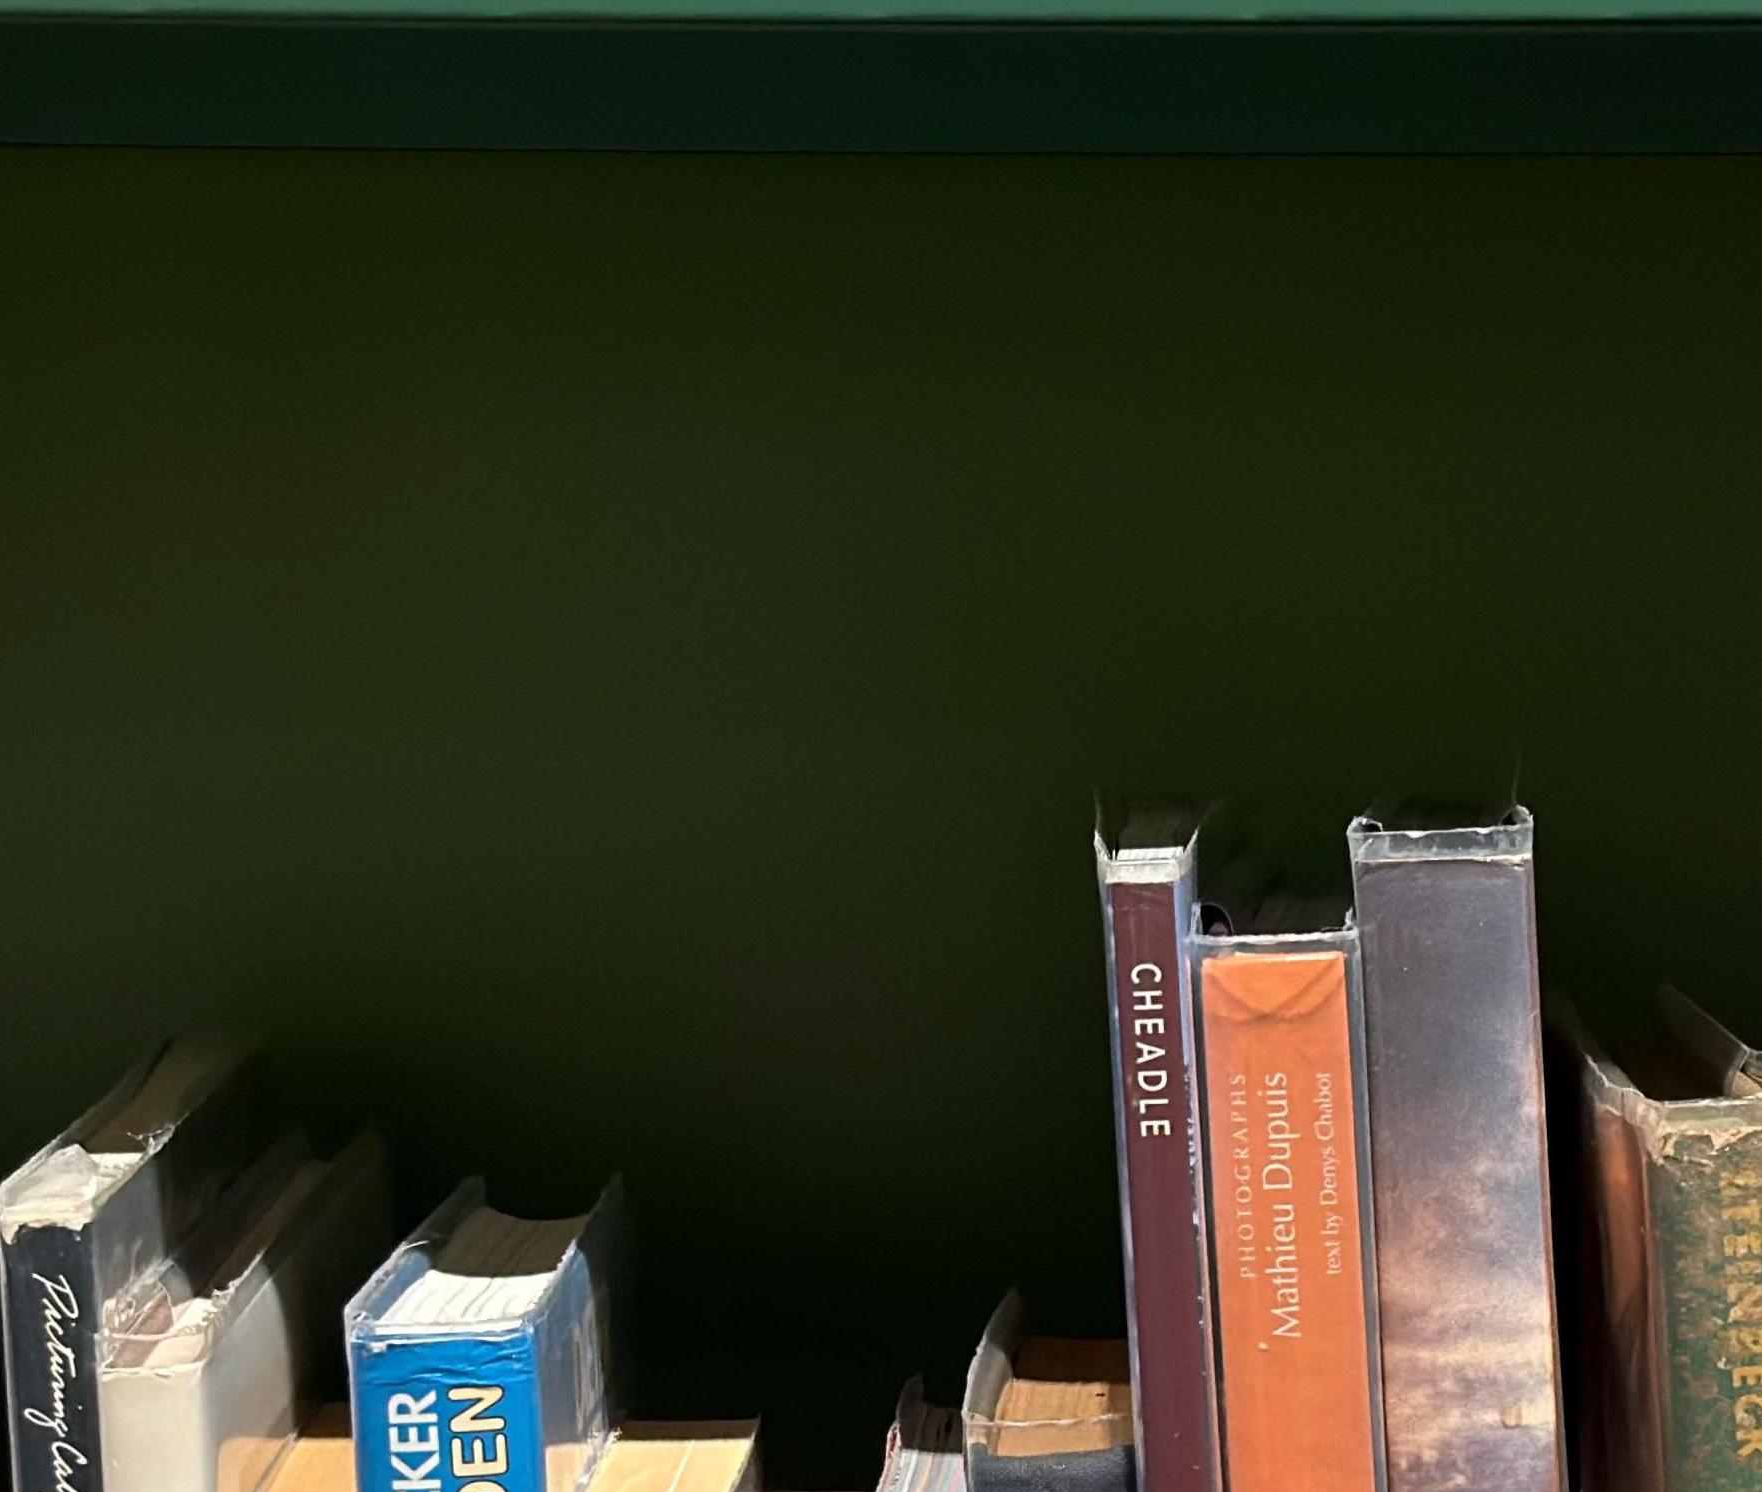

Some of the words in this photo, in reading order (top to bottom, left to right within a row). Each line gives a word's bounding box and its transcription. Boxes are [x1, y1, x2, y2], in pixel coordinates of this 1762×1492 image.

[1128, 962, 1171, 1140] CHEADLE
[1314, 1071, 1334, 1140] Chabot
[1229, 1073, 1256, 1280] PHOTOGRAPHS
[1261, 1071, 1301, 1192] Dupuis
[1319, 1145, 1339, 1206] Denys
[1264, 1202, 1302, 1340] Mathieu
[25, 1272, 83, 1443] Picturing
